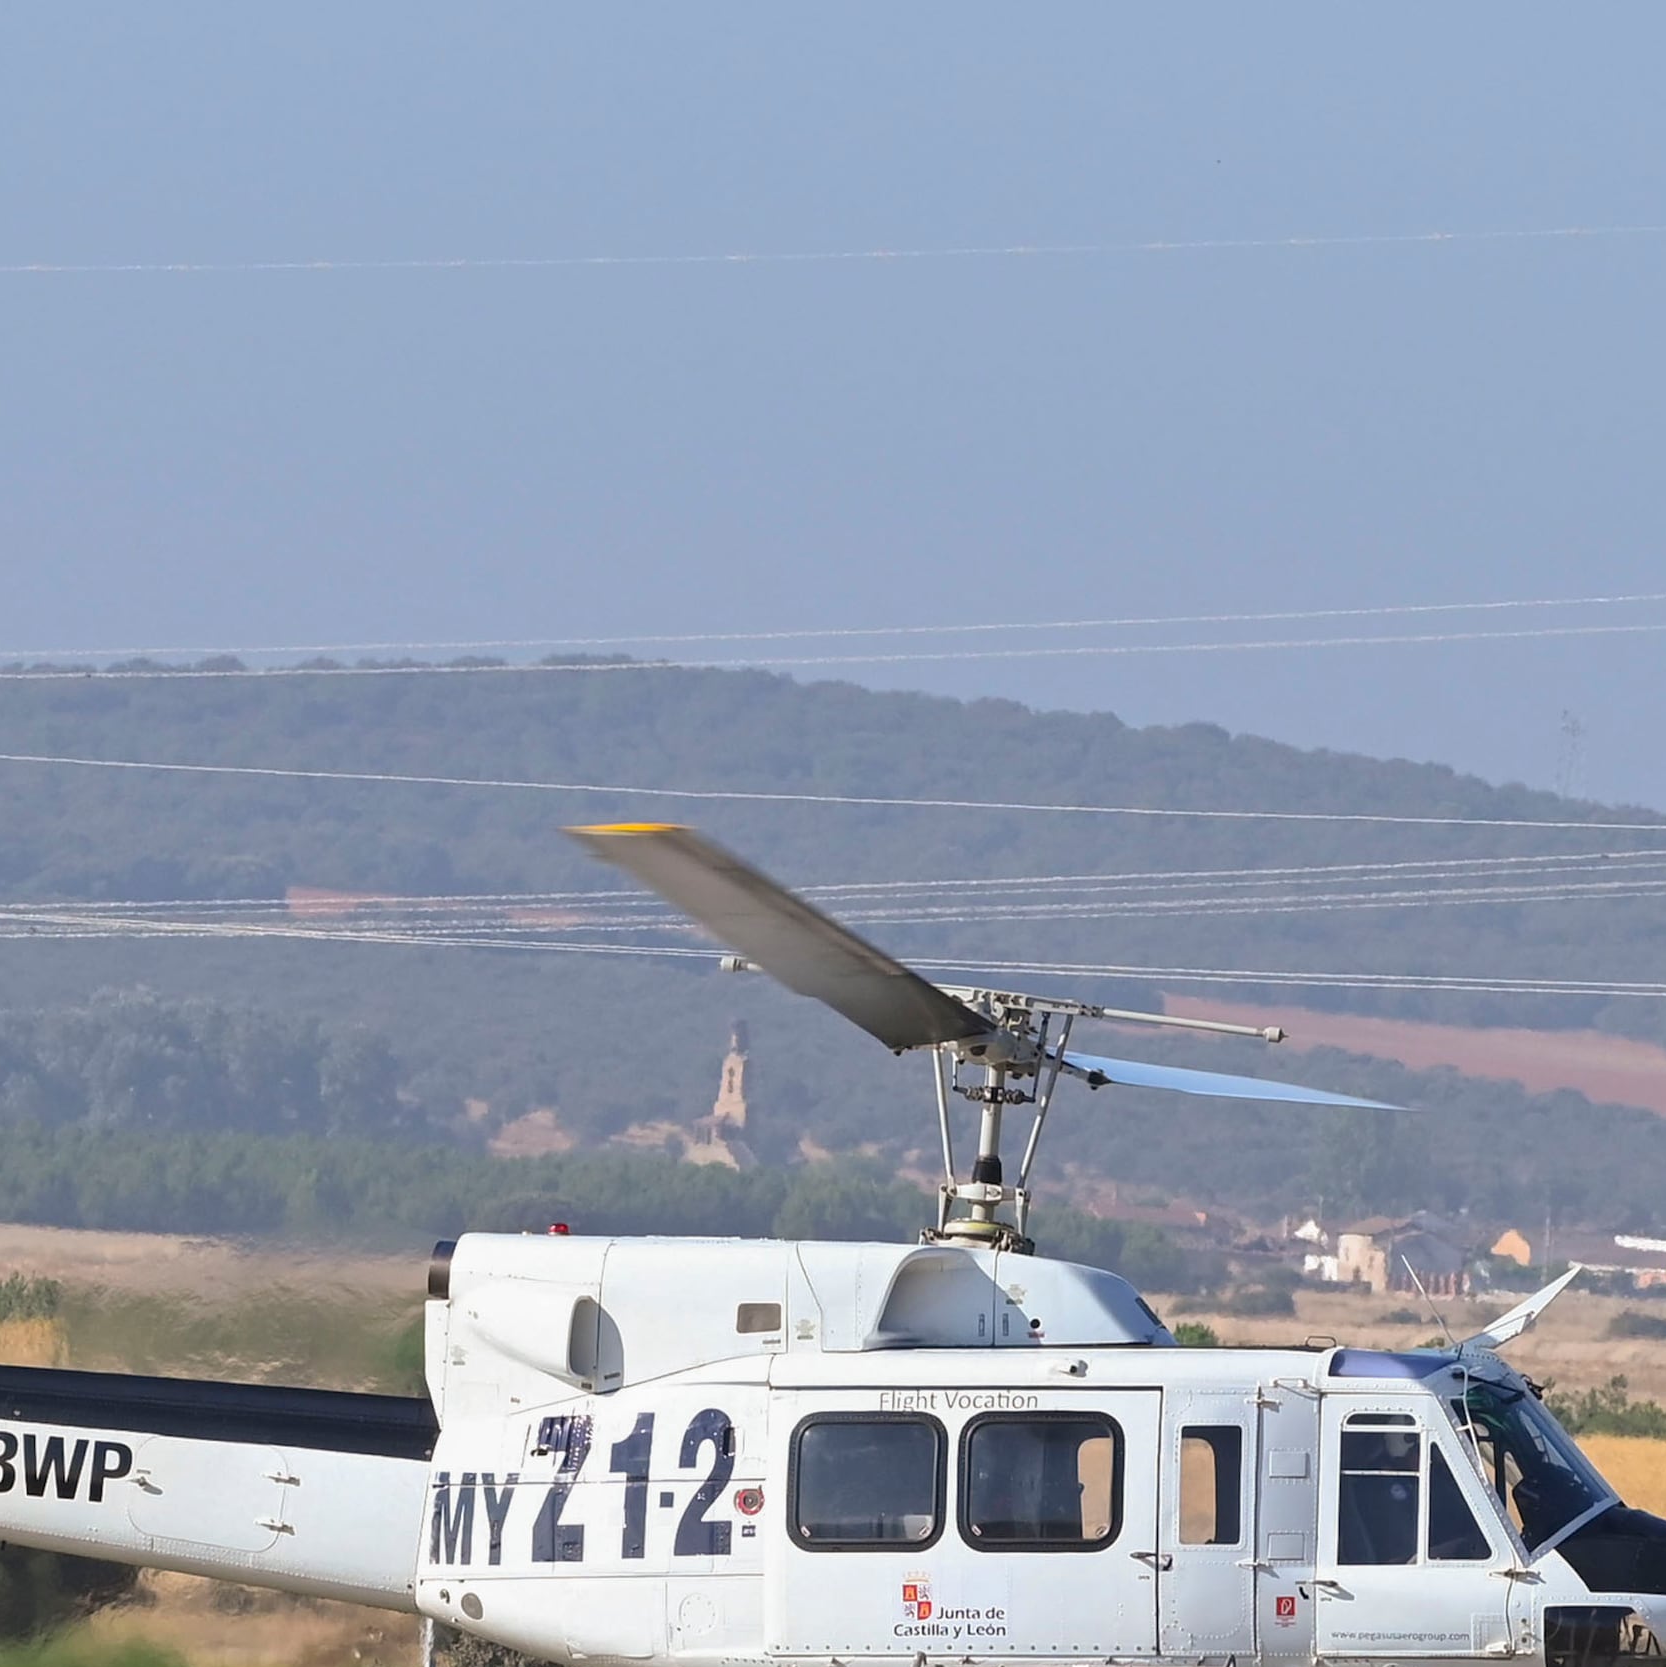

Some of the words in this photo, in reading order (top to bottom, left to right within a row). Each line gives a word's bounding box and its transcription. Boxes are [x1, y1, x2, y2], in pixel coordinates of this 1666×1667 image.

[879, 1390, 937, 1412] Flight
[945, 1390, 1038, 1409] Vocation
[429, 1471, 520, 1566] MY
[937, 1607, 980, 1620] Junta
[985, 1607, 1005, 1620] de
[894, 1623, 949, 1636] Castilla
[952, 1626, 963, 1639] y
[967, 1623, 1006, 1636] León
[1331, 1631, 1470, 1642] www.pegasusaerogroup.com
